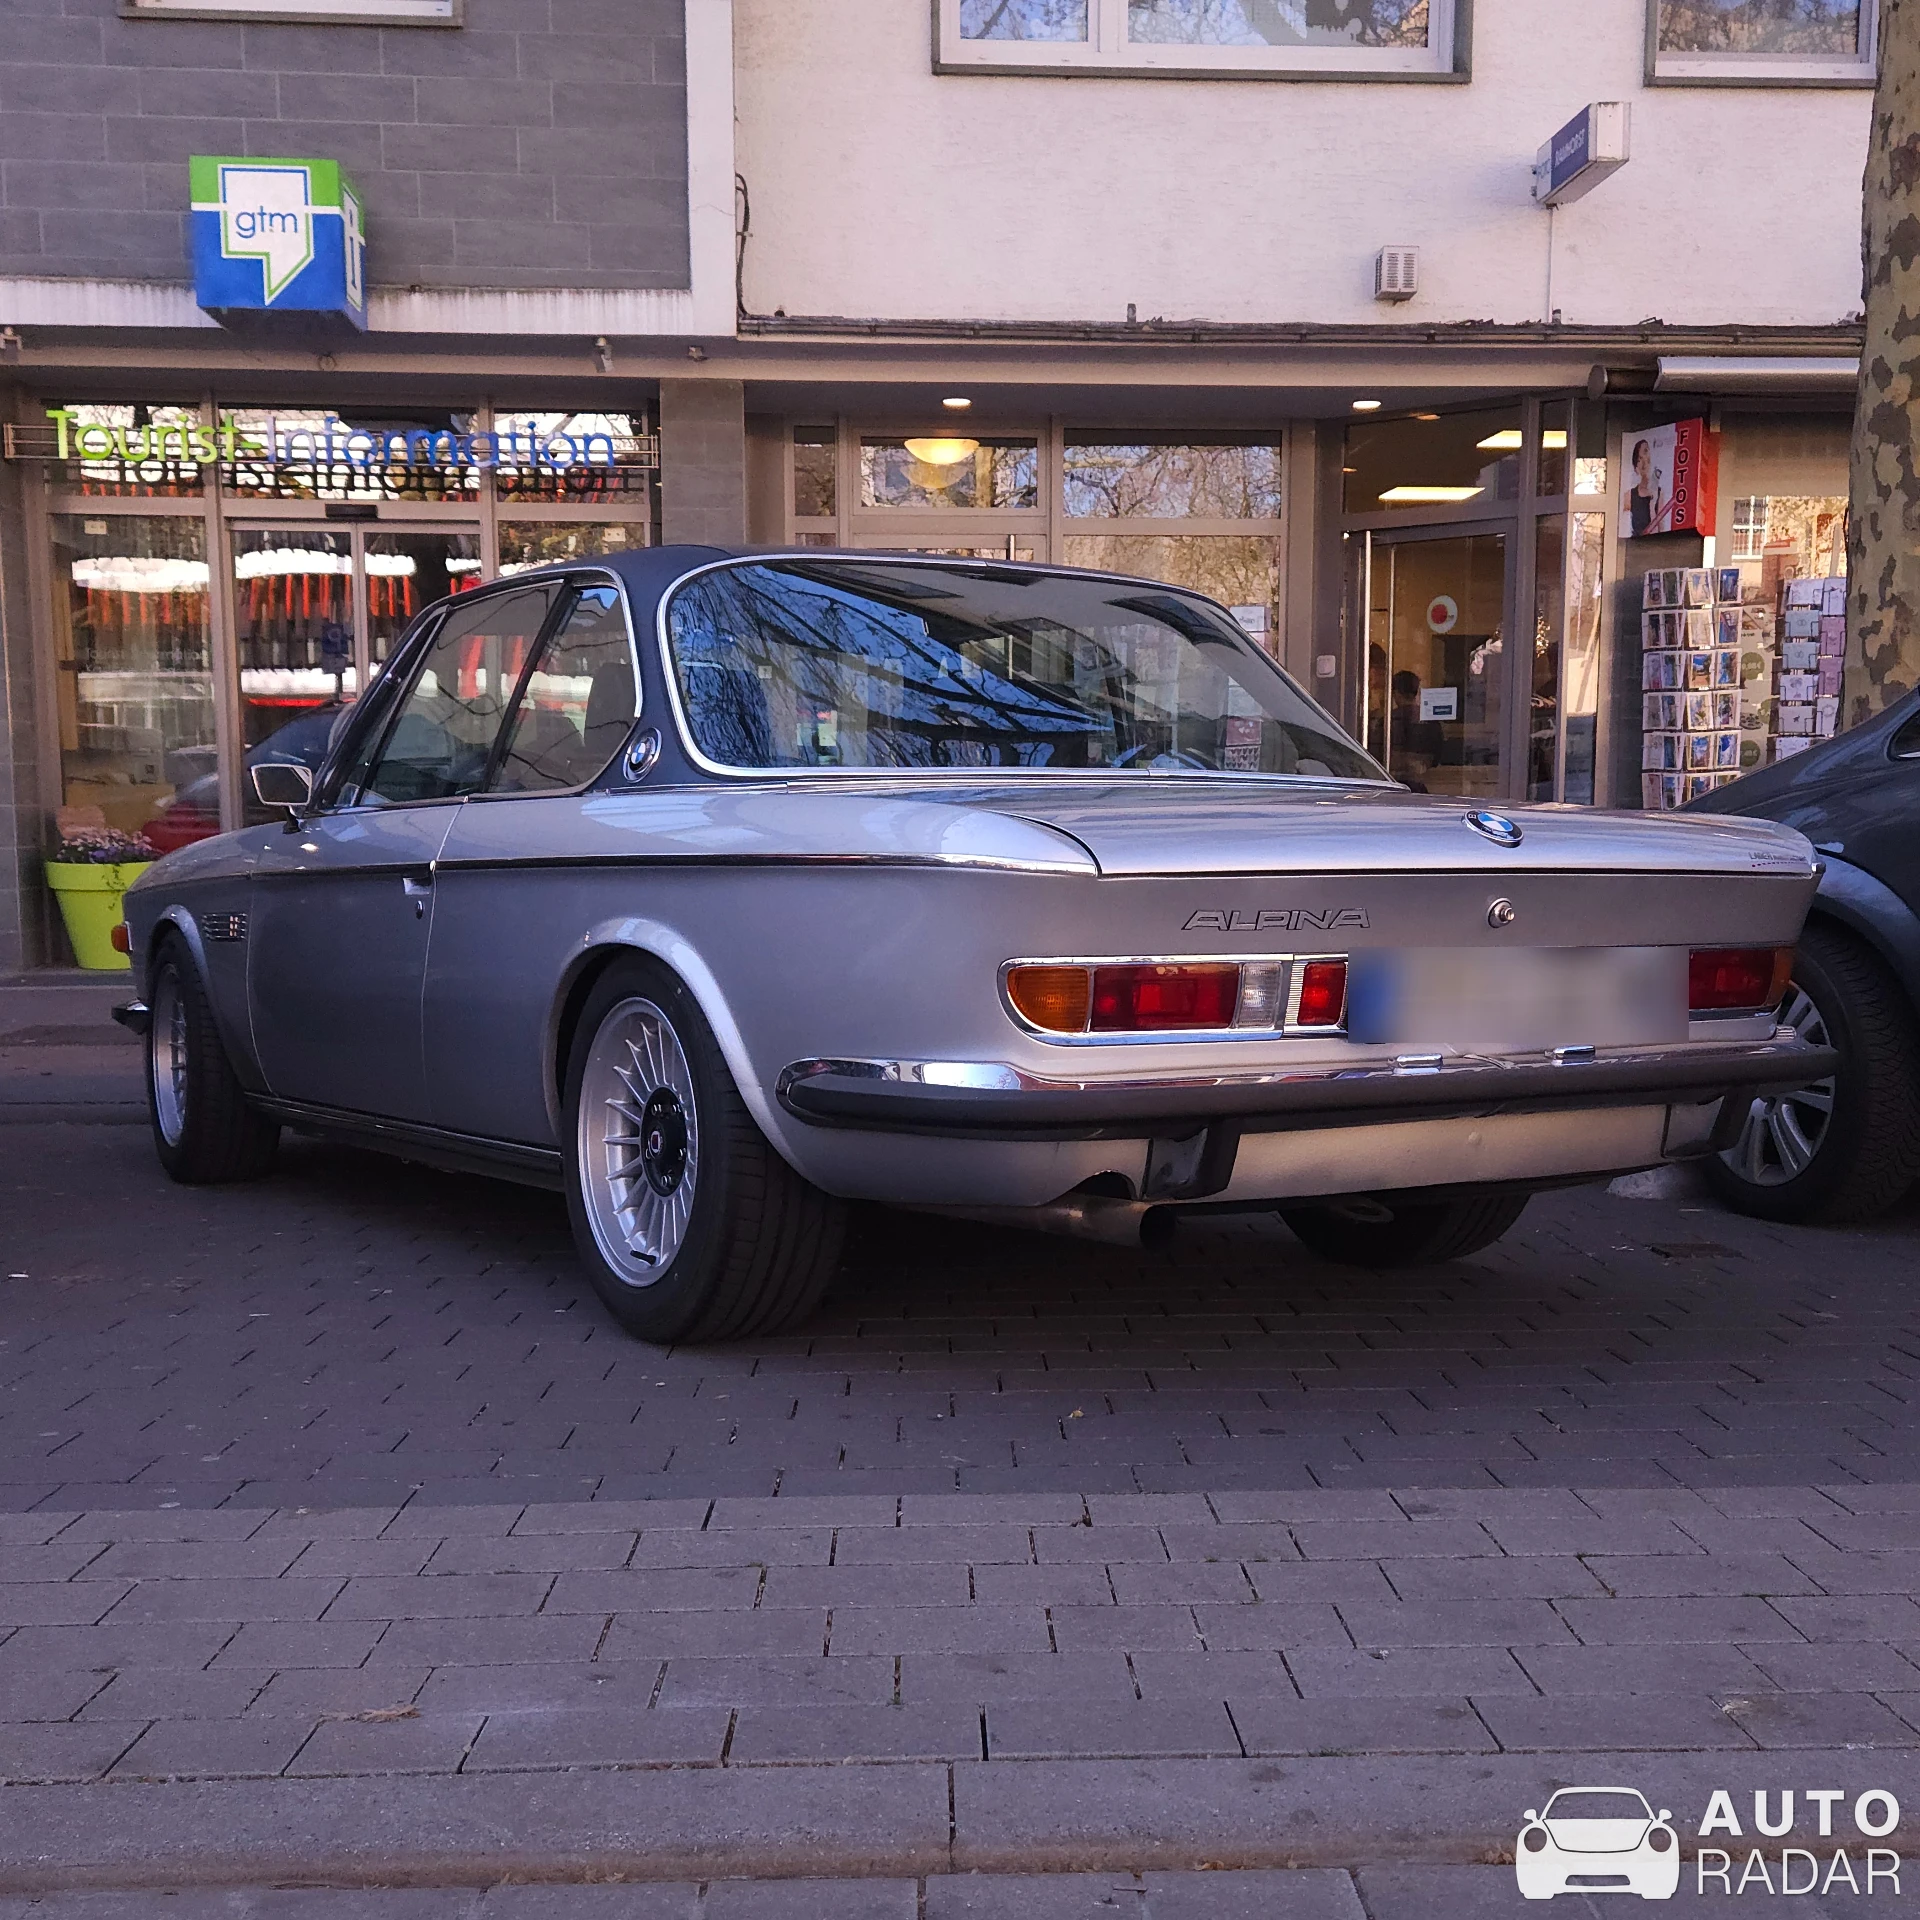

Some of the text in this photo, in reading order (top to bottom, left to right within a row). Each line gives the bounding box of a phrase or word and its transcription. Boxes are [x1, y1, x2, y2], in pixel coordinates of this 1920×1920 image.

[235, 205, 298, 239] gtm
[46, 408, 615, 468] Tourist-Information
[1675, 428, 1690, 525] FOTOS
[1181, 908, 1371, 931] ALPINA
